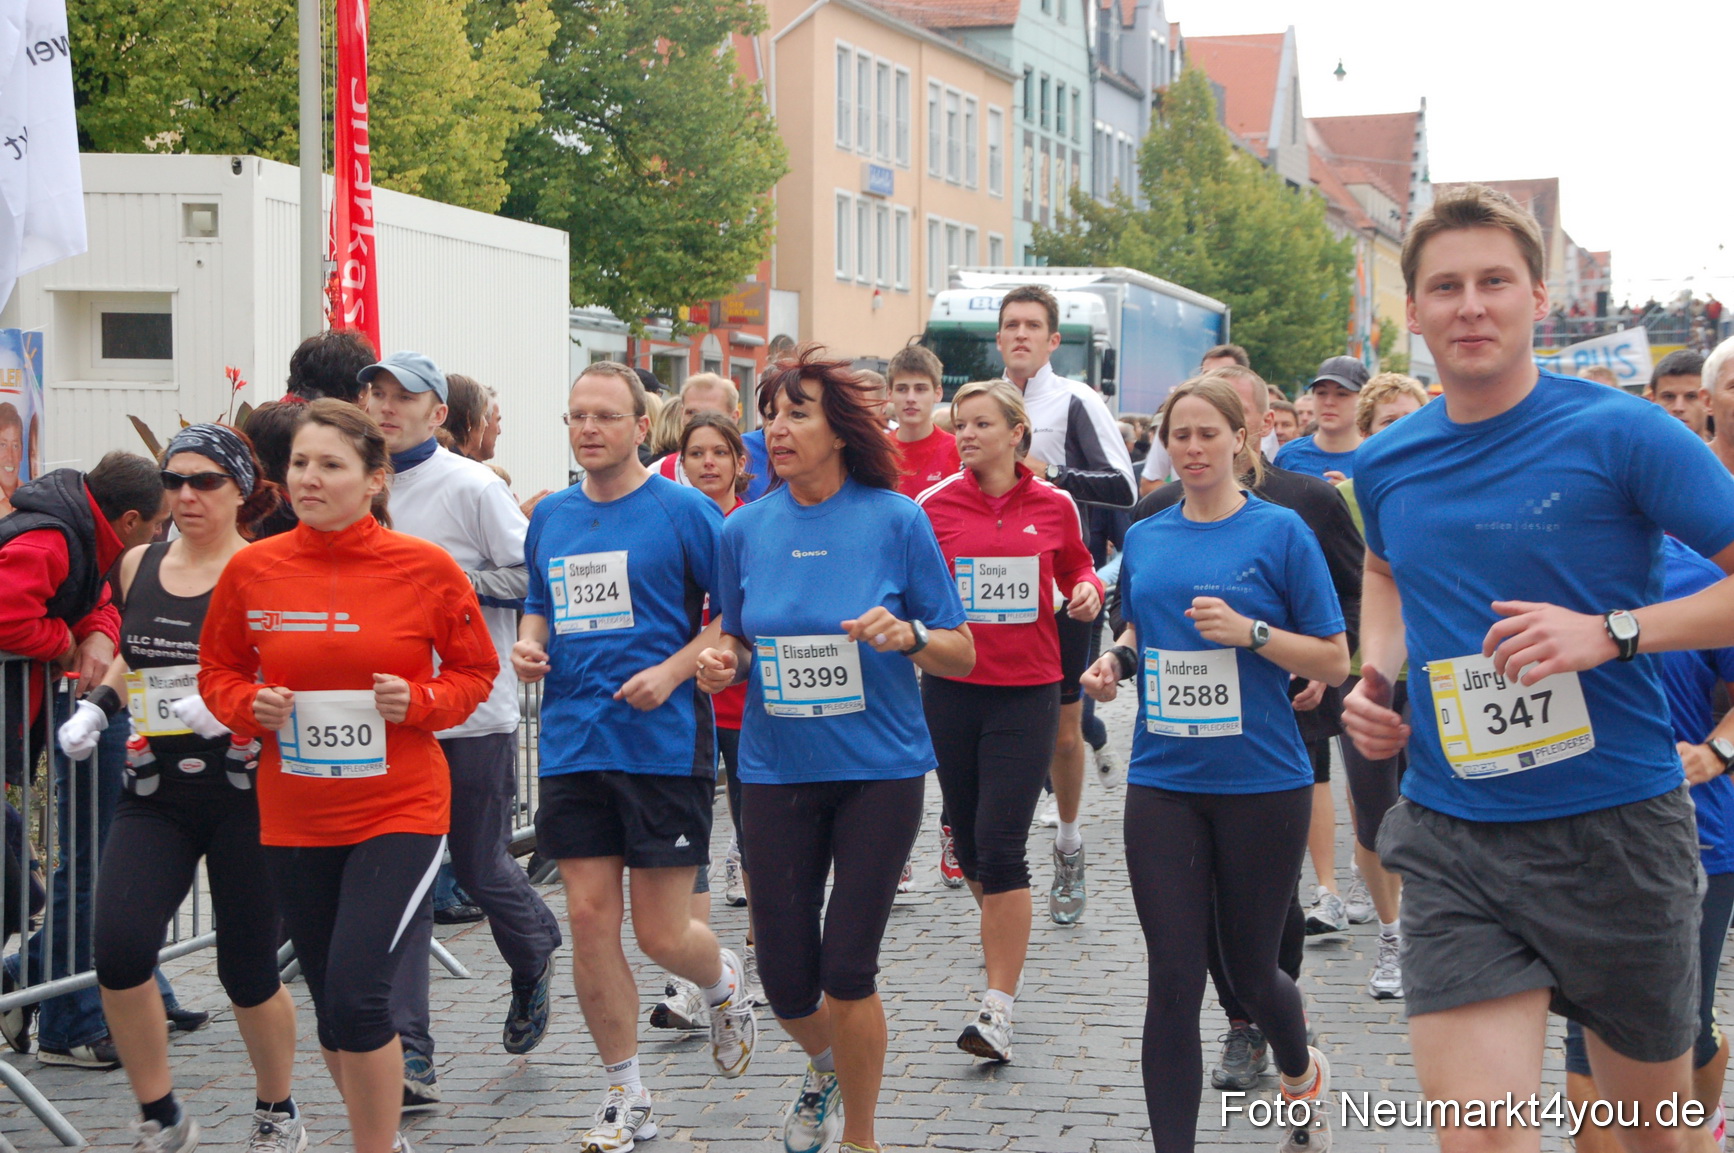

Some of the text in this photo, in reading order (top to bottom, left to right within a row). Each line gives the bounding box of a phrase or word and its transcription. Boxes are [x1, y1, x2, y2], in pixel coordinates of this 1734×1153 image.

[569, 561, 607, 577] Stephan
[979, 563, 1007, 578] Sonja
[574, 580, 620, 604] 3324
[980, 582, 1030, 600] 2419
[127, 634, 151, 645] LLC
[782, 643, 839, 659] Elisabeth
[1165, 659, 1208, 675] Andrea
[787, 665, 848, 689] 3399
[1167, 683, 1229, 707] 2588
[1483, 689, 1553, 736] 347
[306, 723, 372, 748] 3530
[1199, 722, 1240, 732] PFLEIDERER
[1535, 733, 1592, 759] PFLEIDERER
[342, 762, 384, 773] PFLEIDERER
